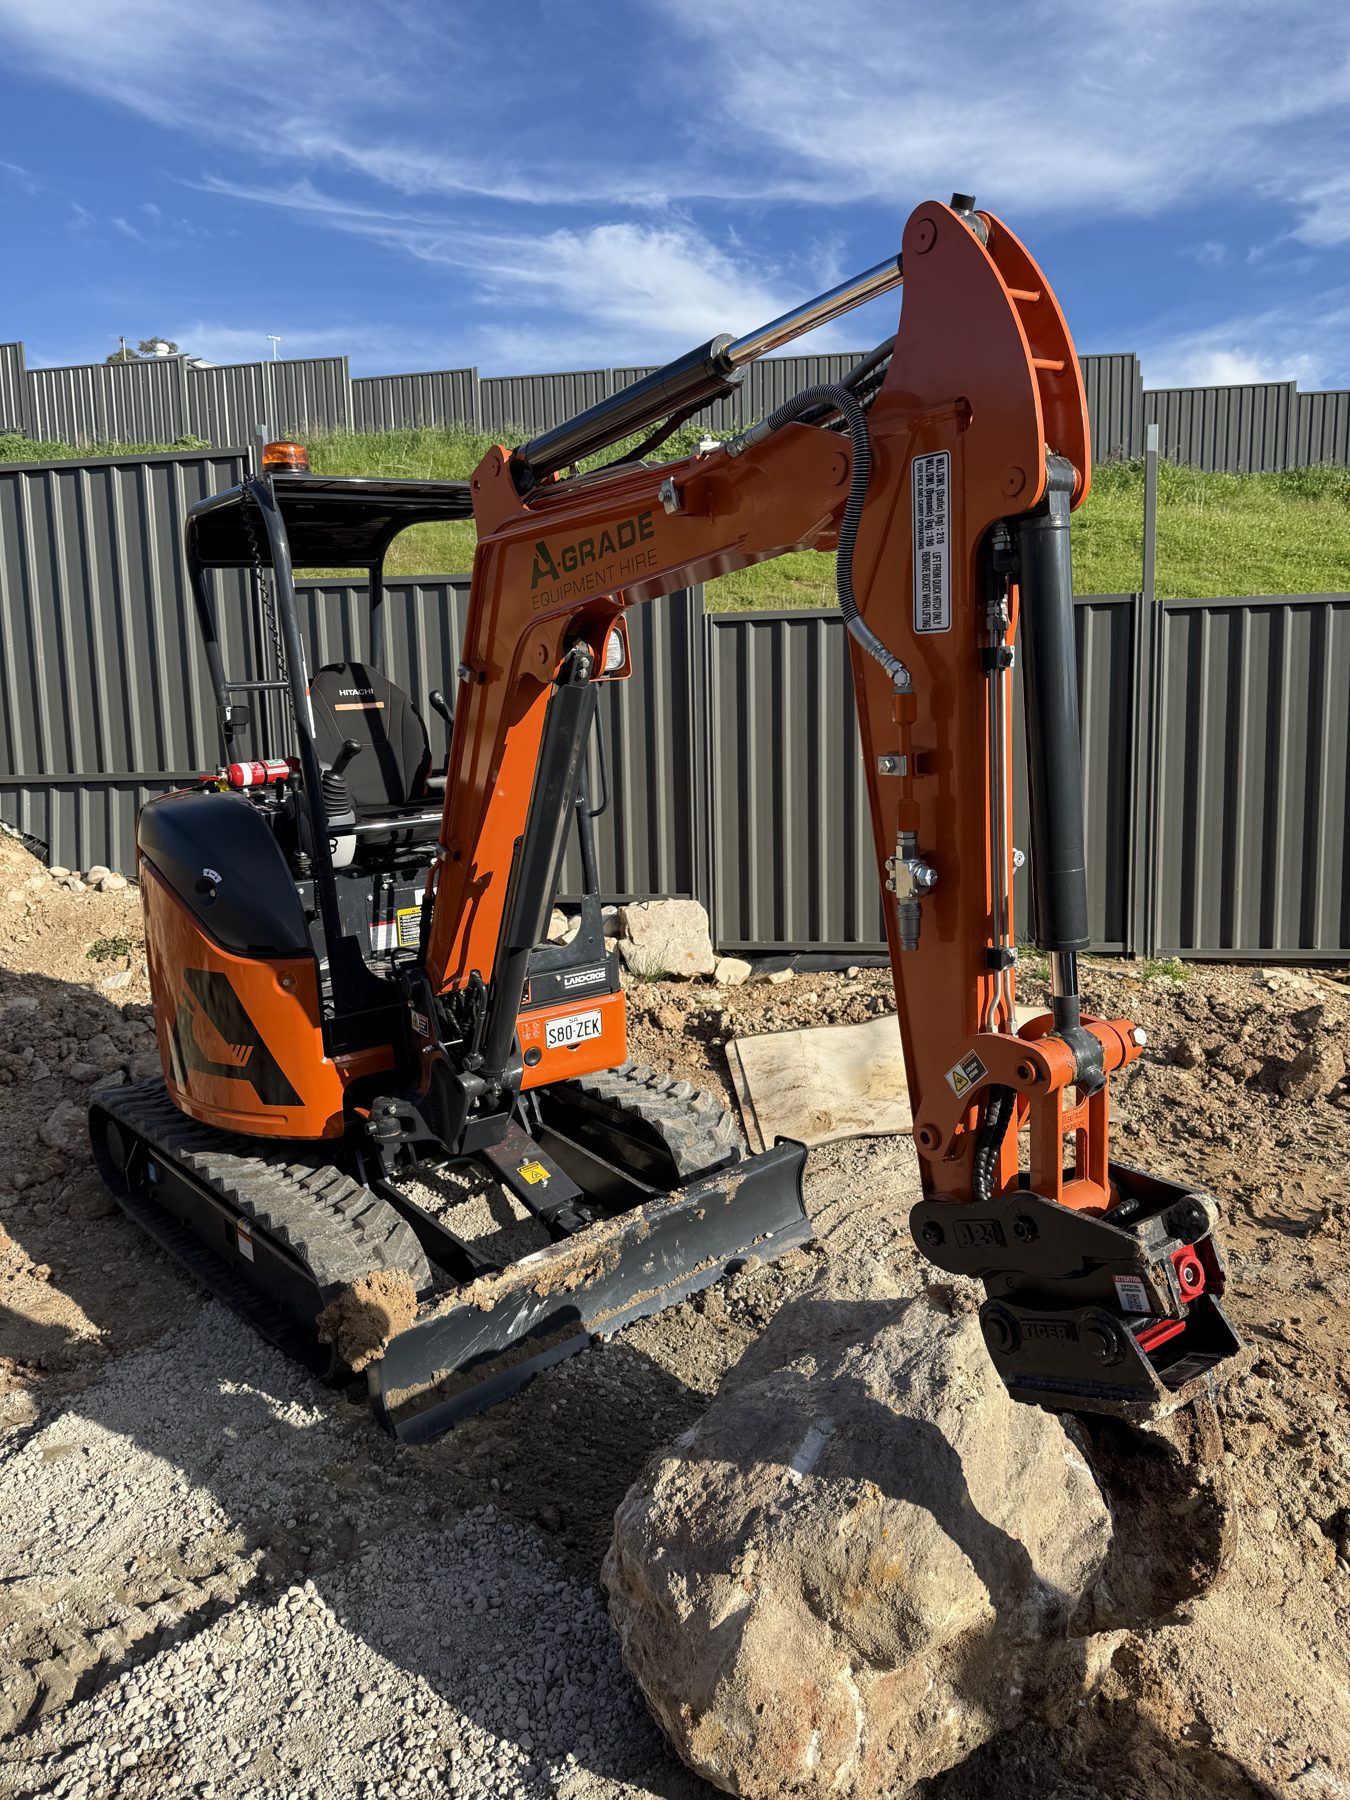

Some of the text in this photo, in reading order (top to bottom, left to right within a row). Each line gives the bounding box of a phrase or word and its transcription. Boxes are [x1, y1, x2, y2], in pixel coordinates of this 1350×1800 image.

[925, 458, 935, 487] WLL/SWL
[935, 457, 945, 488] WLL/SWL
[924, 488, 935, 518] (Dynamic)
[935, 489, 945, 512] (Static)
[924, 519, 935, 531] (kg)
[935, 514, 945, 526] (kg)
[936, 531, 945, 544] 210
[532, 548, 658, 611] EQUIPMENT HIRE
[921, 551, 931, 629] REMOVE BUCKET WHEN LIFTING
[932, 551, 941, 625] LIFT FROM QUICK HITCH ONLY
[338, 687, 374, 697] HITACHI
[564, 971, 606, 986] LANDCROS
[1023, 1325, 1067, 1338] TIGER
